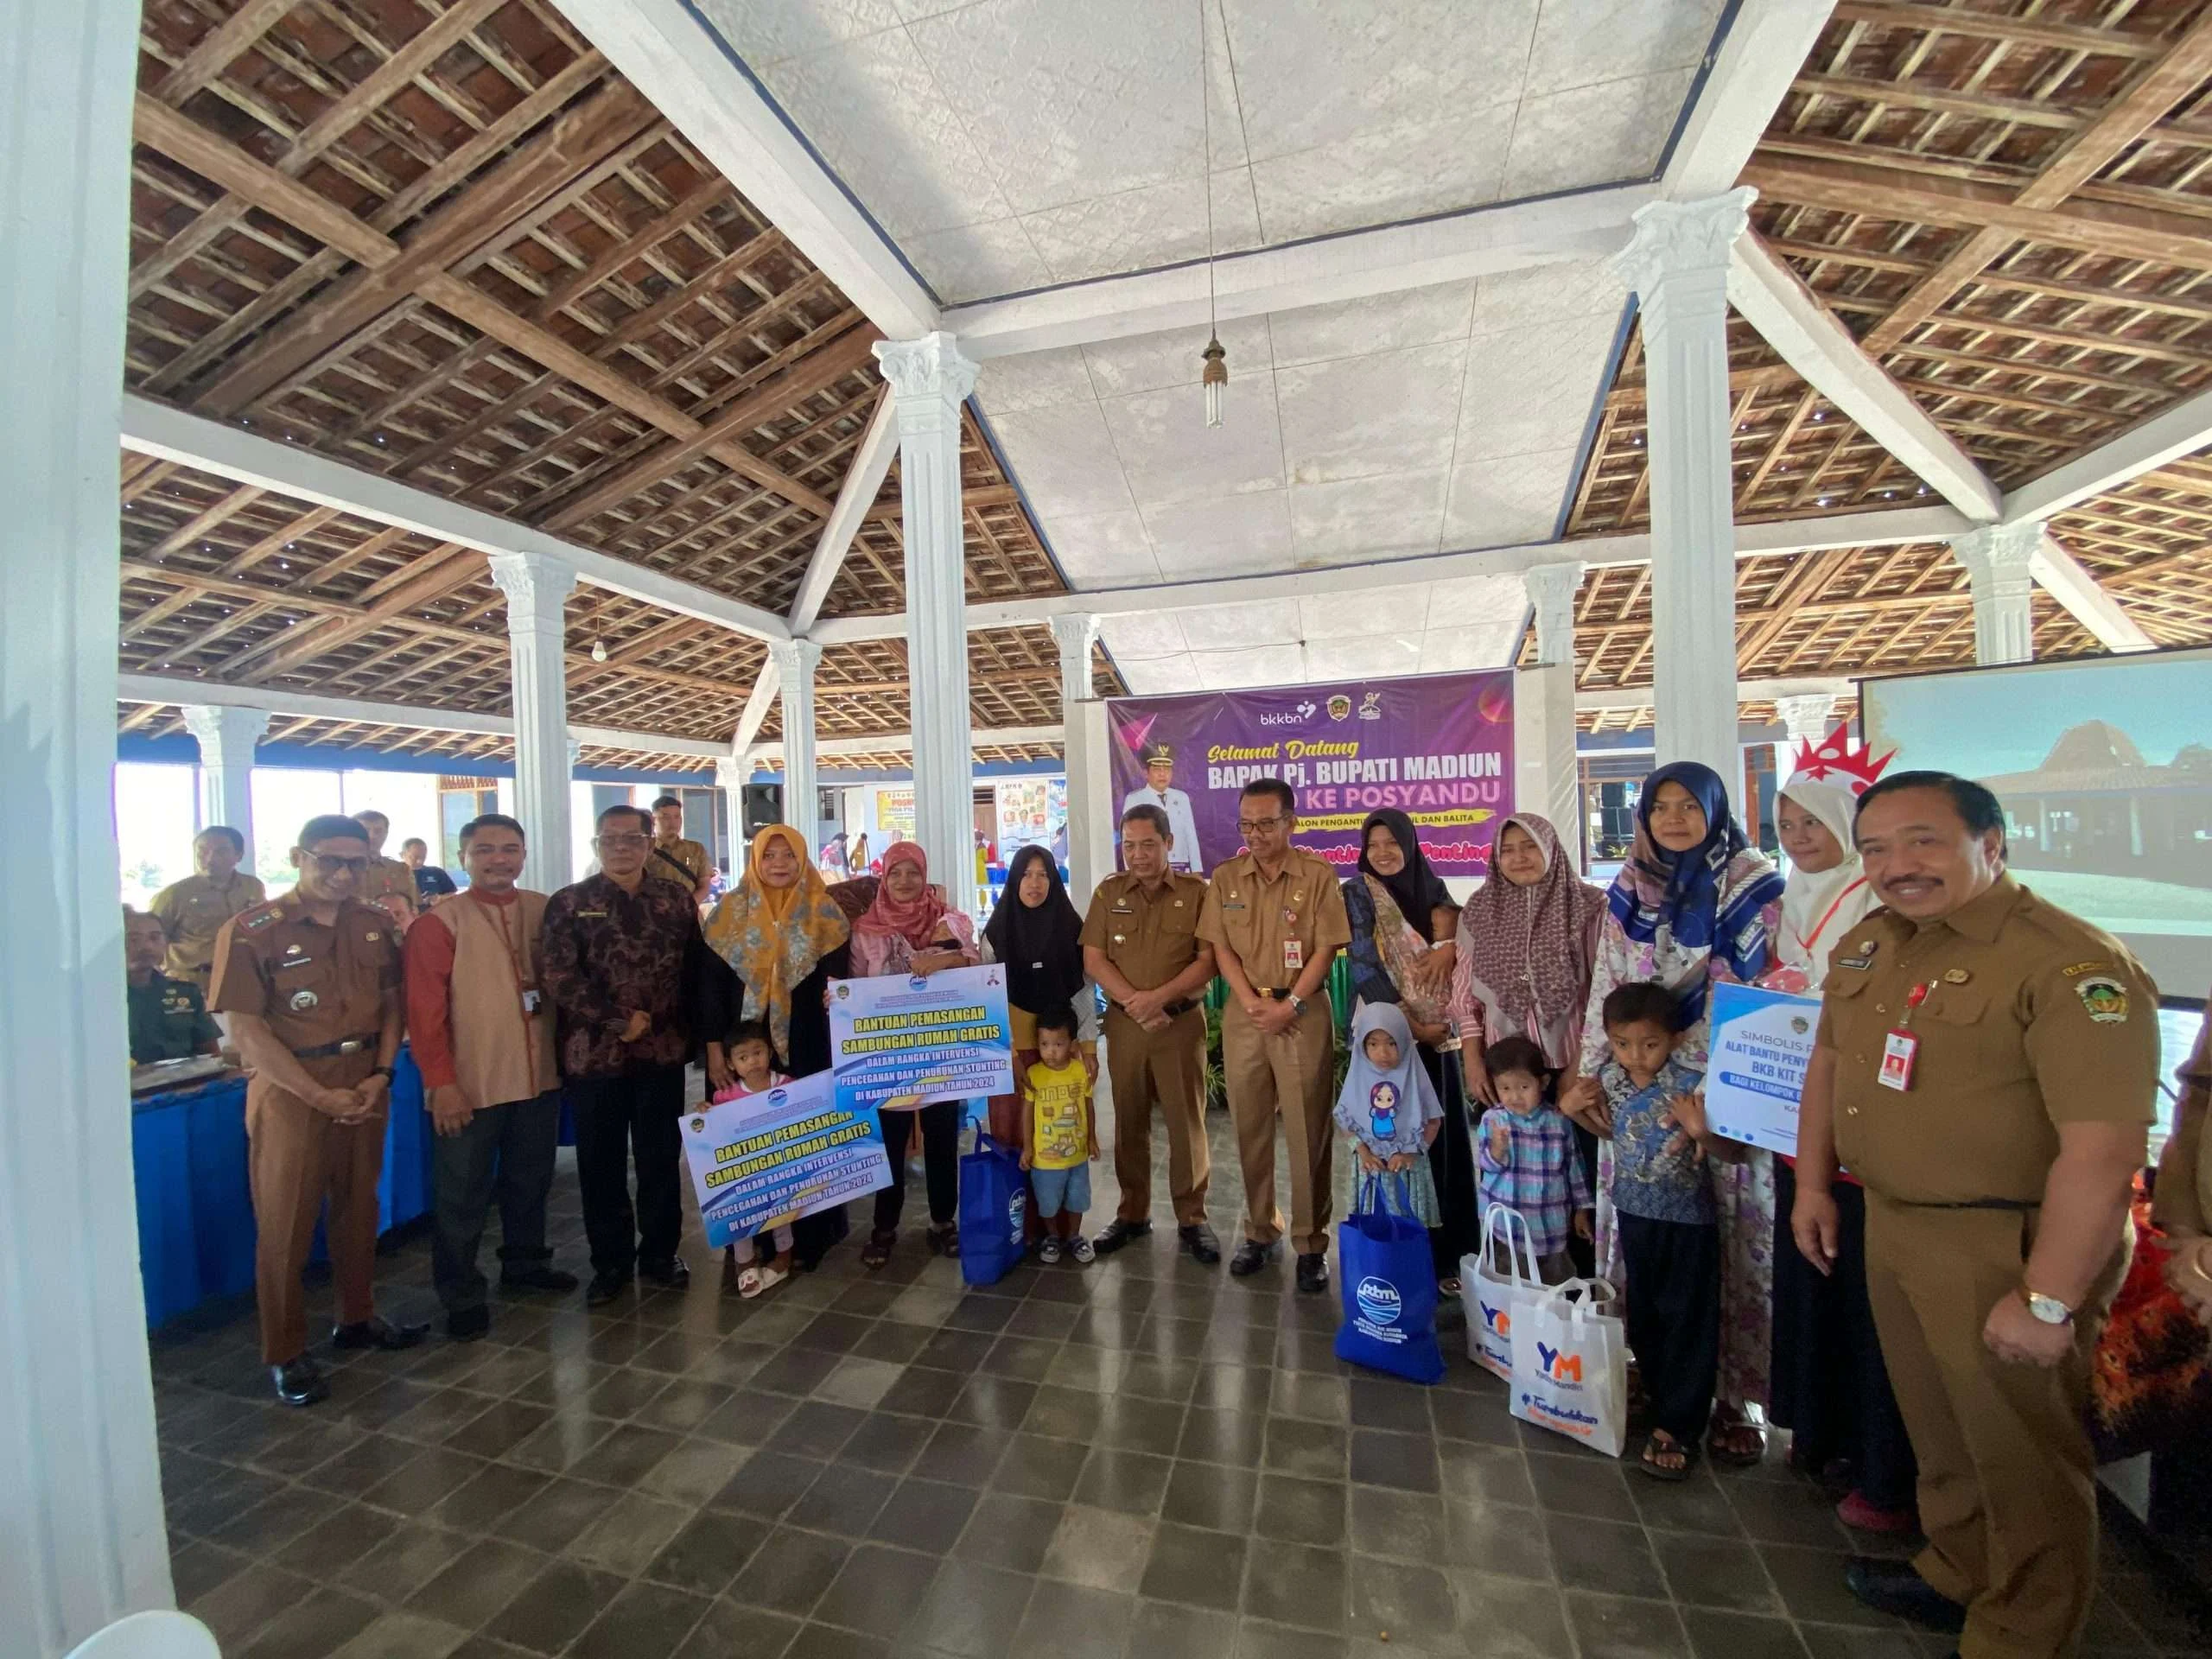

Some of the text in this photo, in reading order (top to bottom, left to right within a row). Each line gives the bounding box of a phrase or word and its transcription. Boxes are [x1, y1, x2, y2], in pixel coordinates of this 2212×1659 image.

[1260, 713, 1302, 726] bkkbn
[1208, 740, 1359, 763] Selamat Datang
[1316, 758, 1397, 785] BUPATI
[1403, 752, 1502, 780] MADIUN
[1306, 788, 1338, 810] KE
[1345, 781, 1500, 809] POSYANDU
[1319, 817, 1363, 827] PENGANTI
[1444, 814, 1474, 823] BALITA
[854, 1006, 986, 1033] BANTUAN PEMASANGAN
[842, 1025, 1001, 1055] SAMBUNGAN RUMAH GRATIS
[1726, 1040, 1749, 1054] ALAT
[1749, 1046, 1780, 1063] BANTU
[1741, 1030, 1802, 1052] SIMBOLIS
[866, 1046, 980, 1068] DALAM RANGKA INTERVENSI
[841, 1072, 895, 1086] PENCEGAHAN
[897, 1069, 913, 1080] DAN
[965, 1060, 1007, 1073] STUNTING
[1751, 1061, 1775, 1077] BKB
[1777, 1067, 1796, 1082] KIT
[855, 1077, 995, 1101] DI KABUPATEN MADIUN TAHUN 2024
[705, 1121, 872, 1189] SAMBUNGAN RUMAH GRATIS
[715, 1131, 774, 1164] BANTUAN
[735, 1178, 766, 1195] DALAM
[804, 1148, 853, 1172] INTERVENSI
[711, 1192, 769, 1220] PENCEGAHAN
[840, 1154, 882, 1176] STUNTING
[728, 1173, 874, 1232] DI KABUPATEN MADIUN TAHUN 2024
[1537, 1341, 1582, 1382] YM
